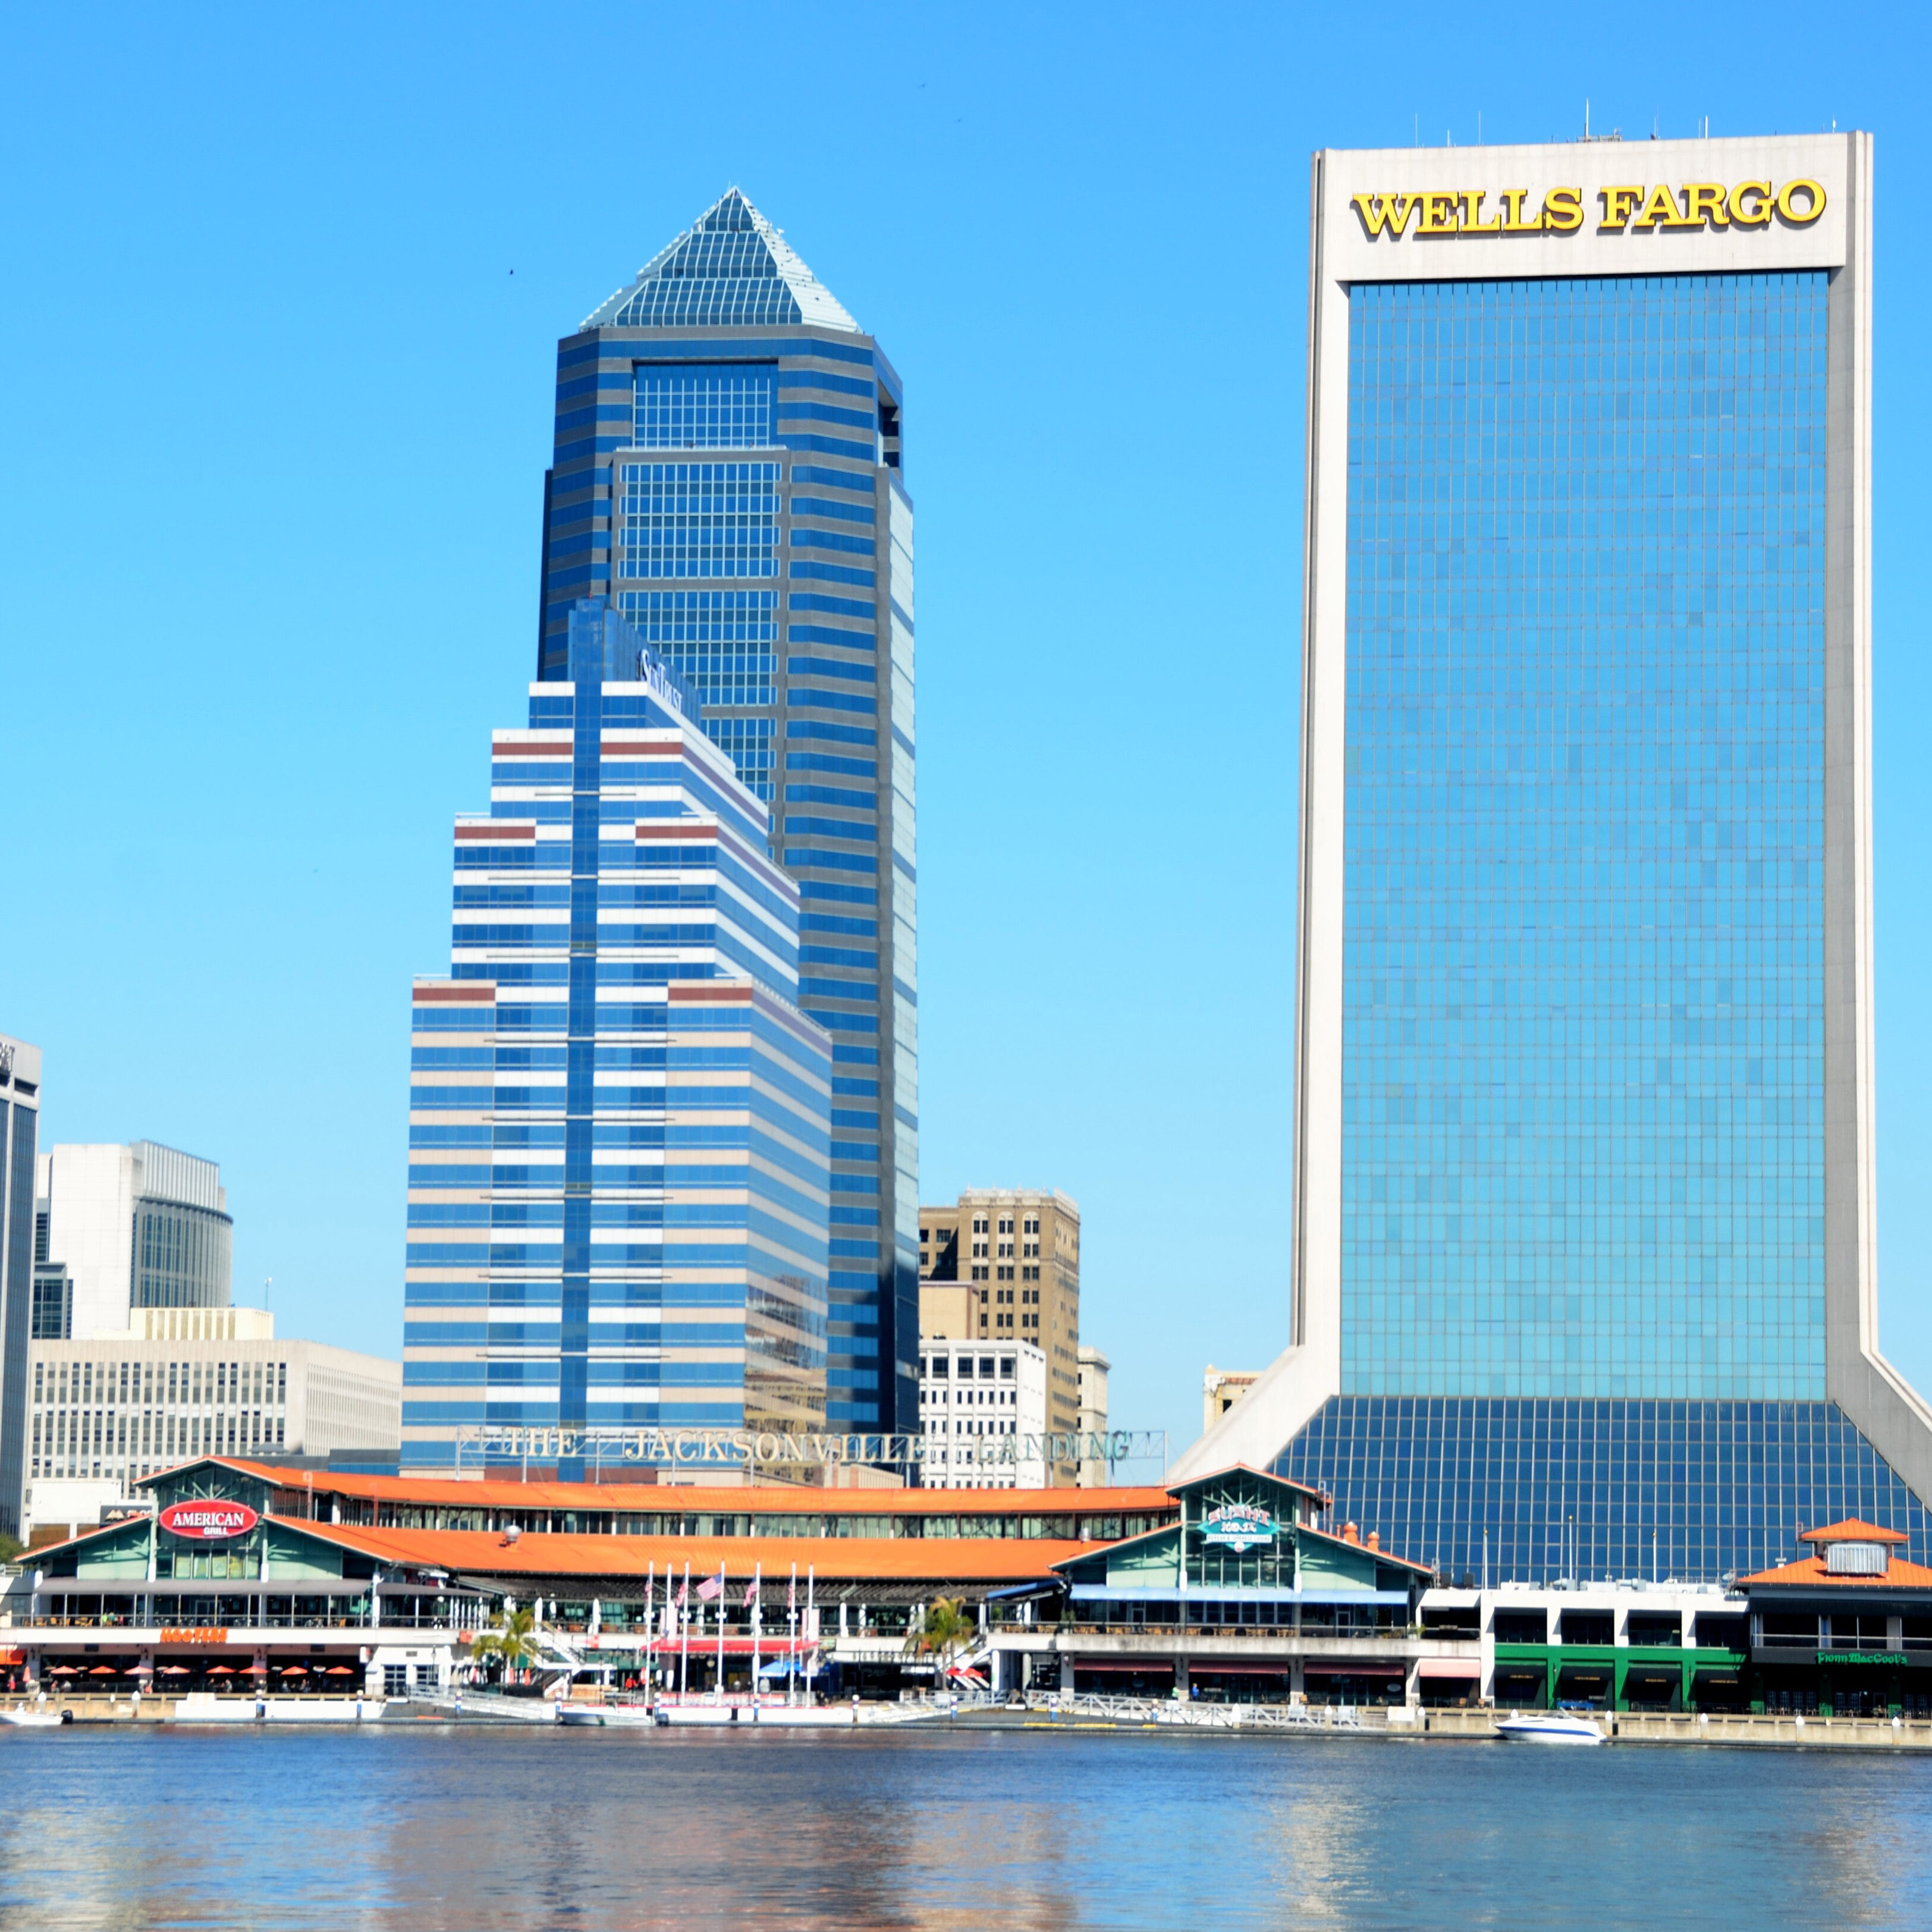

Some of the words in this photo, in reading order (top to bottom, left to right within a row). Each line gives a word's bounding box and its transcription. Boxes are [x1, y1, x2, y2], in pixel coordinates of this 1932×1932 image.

[1353, 186, 1584, 234] WELLS
[1600, 179, 1827, 228] FARGO
[503, 1427, 577, 1457] THE
[625, 1430, 925, 1463] JACKSONVILLE
[972, 1430, 1129, 1462] LANDING
[172, 1512, 244, 1526] AMERICAN
[1208, 1504, 1270, 1527] SUSHI
[203, 1526, 228, 1536] GRILL
[160, 1627, 227, 1643] HOOTERS
[1817, 1651, 1848, 1664] Fionn
